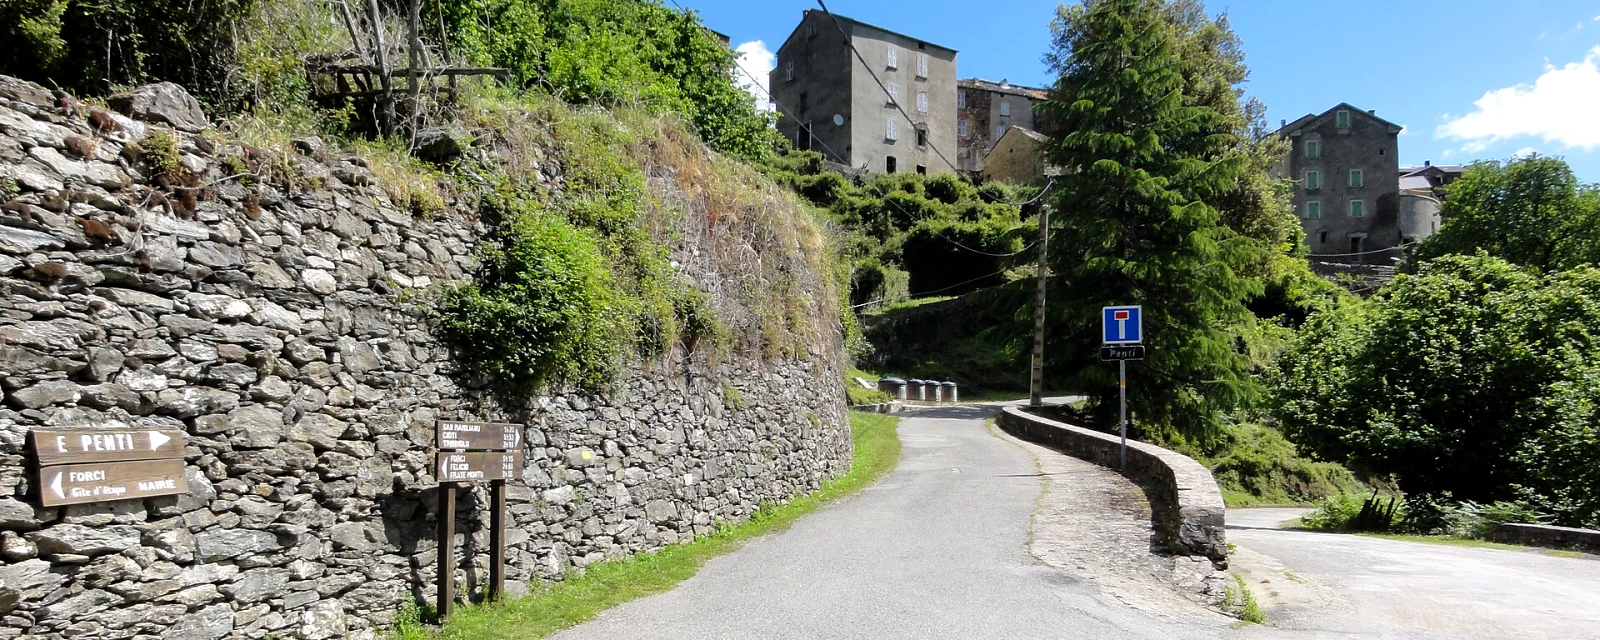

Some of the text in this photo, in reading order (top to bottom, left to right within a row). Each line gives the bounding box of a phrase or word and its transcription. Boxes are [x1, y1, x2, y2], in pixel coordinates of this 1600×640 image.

[1109, 347, 1136, 358] Penti
[57, 434, 134, 453] E PENTI
[450, 455, 466, 463] FORCI
[69, 470, 106, 482] FORCI
[449, 471, 467, 479] FRATE
[137, 480, 176, 491] MAIRIE
